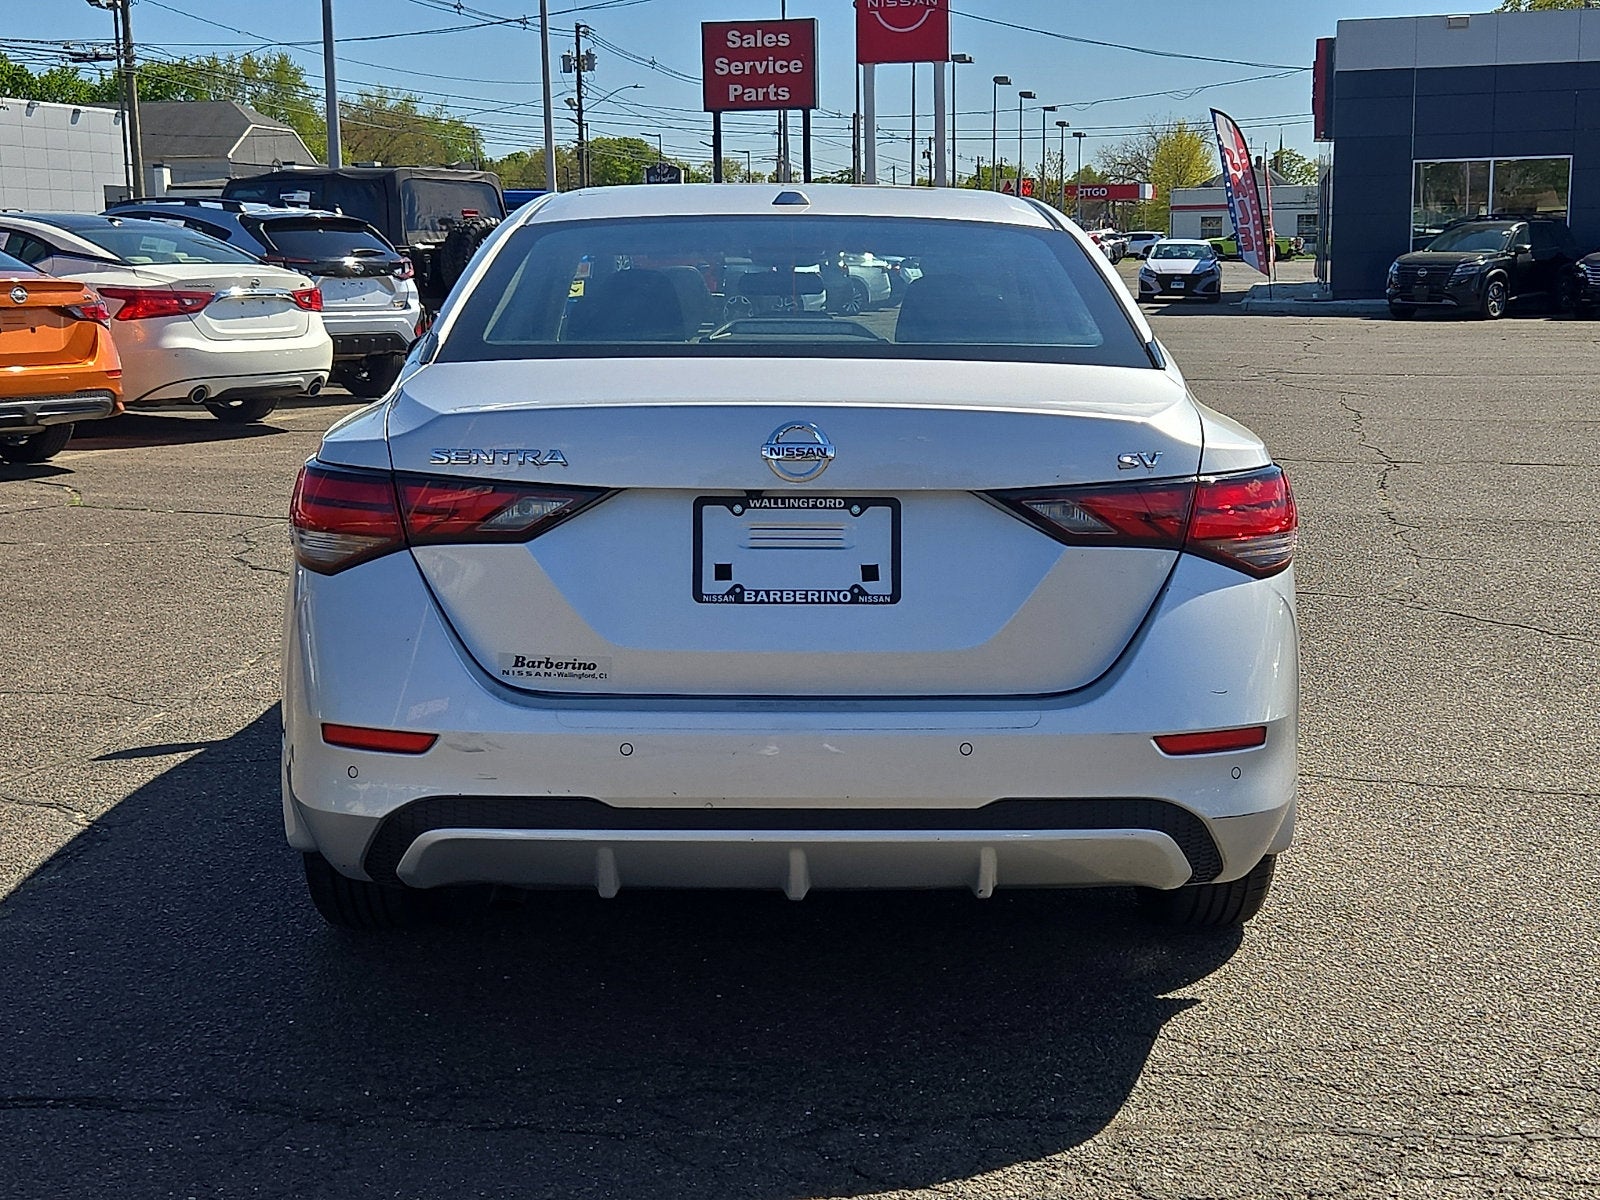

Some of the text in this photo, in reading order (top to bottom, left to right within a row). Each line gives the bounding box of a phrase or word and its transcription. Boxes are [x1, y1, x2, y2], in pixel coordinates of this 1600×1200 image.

[867, 0, 938, 8] NISSAN
[726, 30, 790, 48] Sales
[714, 56, 803, 75] Service
[728, 84, 790, 102] Parts
[1076, 187, 1108, 197] CITGO
[429, 447, 569, 467] SENTRA
[769, 446, 827, 457] NISSAN
[1117, 450, 1163, 470] SV
[749, 498, 845, 508] WALLINGFORD
[702, 590, 891, 603] NISSAN BARBERINO NISSAN
[512, 655, 597, 671] Barberino
[501, 669, 552, 678] NISSAN
